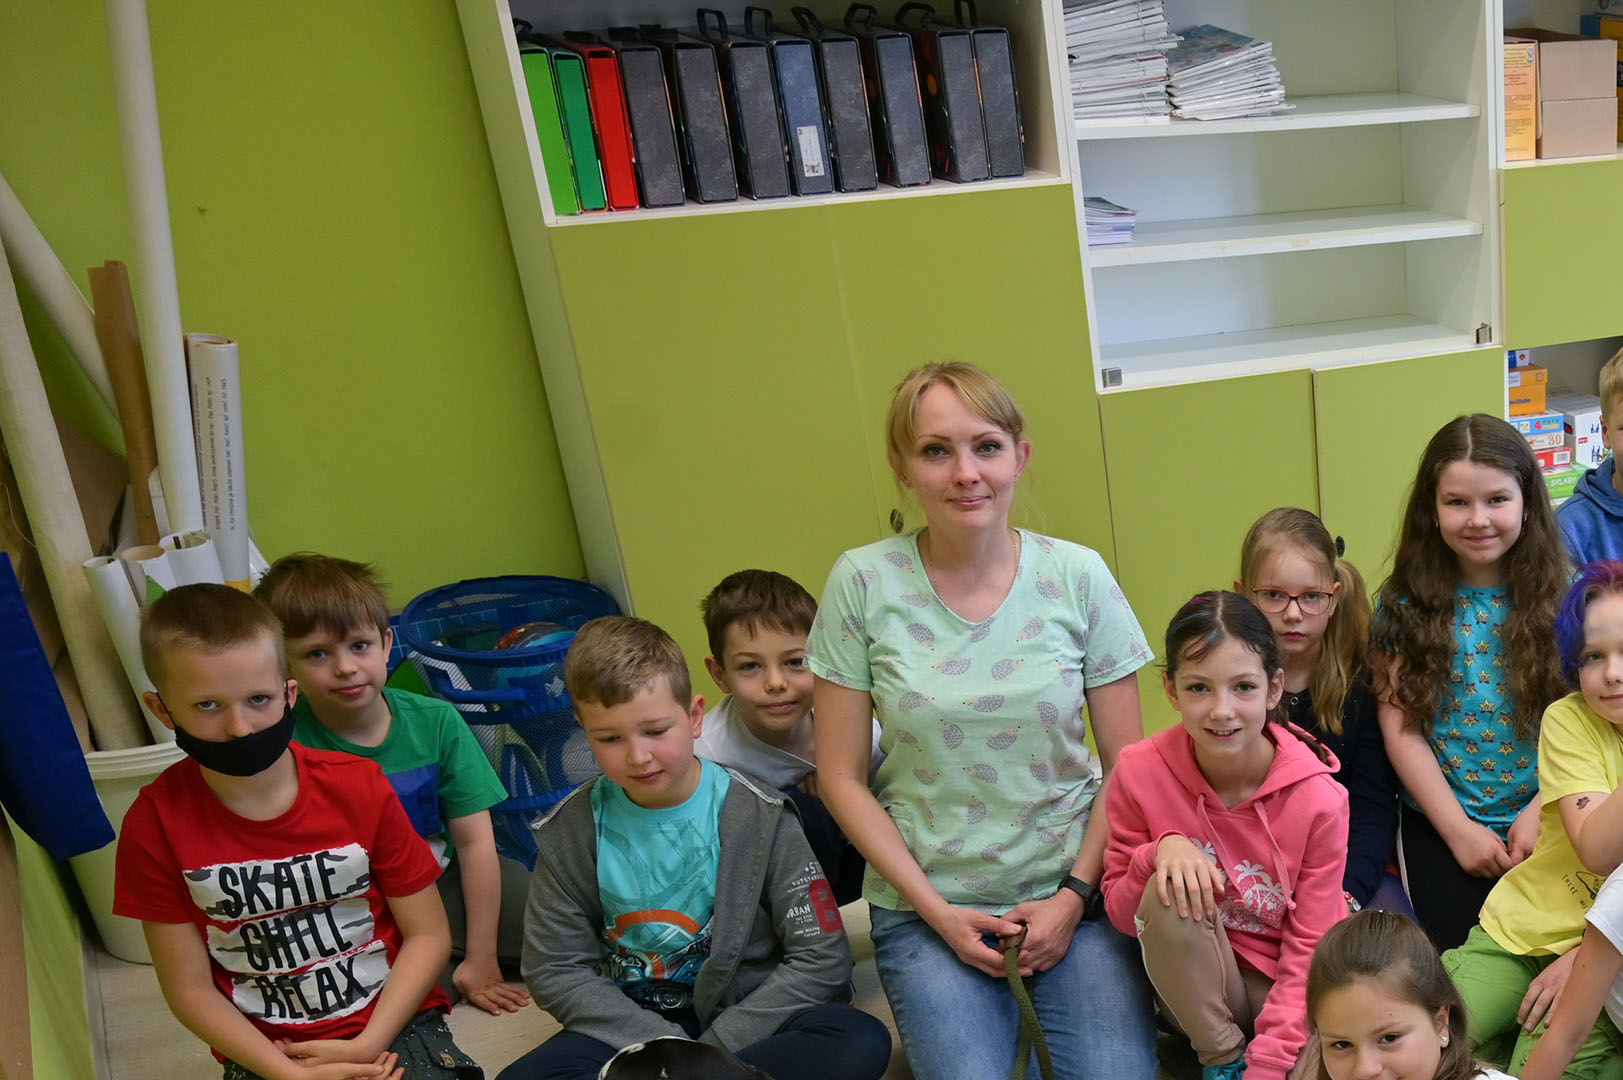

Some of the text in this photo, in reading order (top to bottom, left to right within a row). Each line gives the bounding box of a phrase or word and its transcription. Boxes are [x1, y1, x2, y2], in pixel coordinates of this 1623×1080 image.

[1548, 434, 1562, 446] 30
[1551, 476, 1577, 488] SYLABY
[218, 851, 342, 919] SKATE
[240, 904, 353, 972] CHILL
[254, 955, 369, 1019] RELAX
